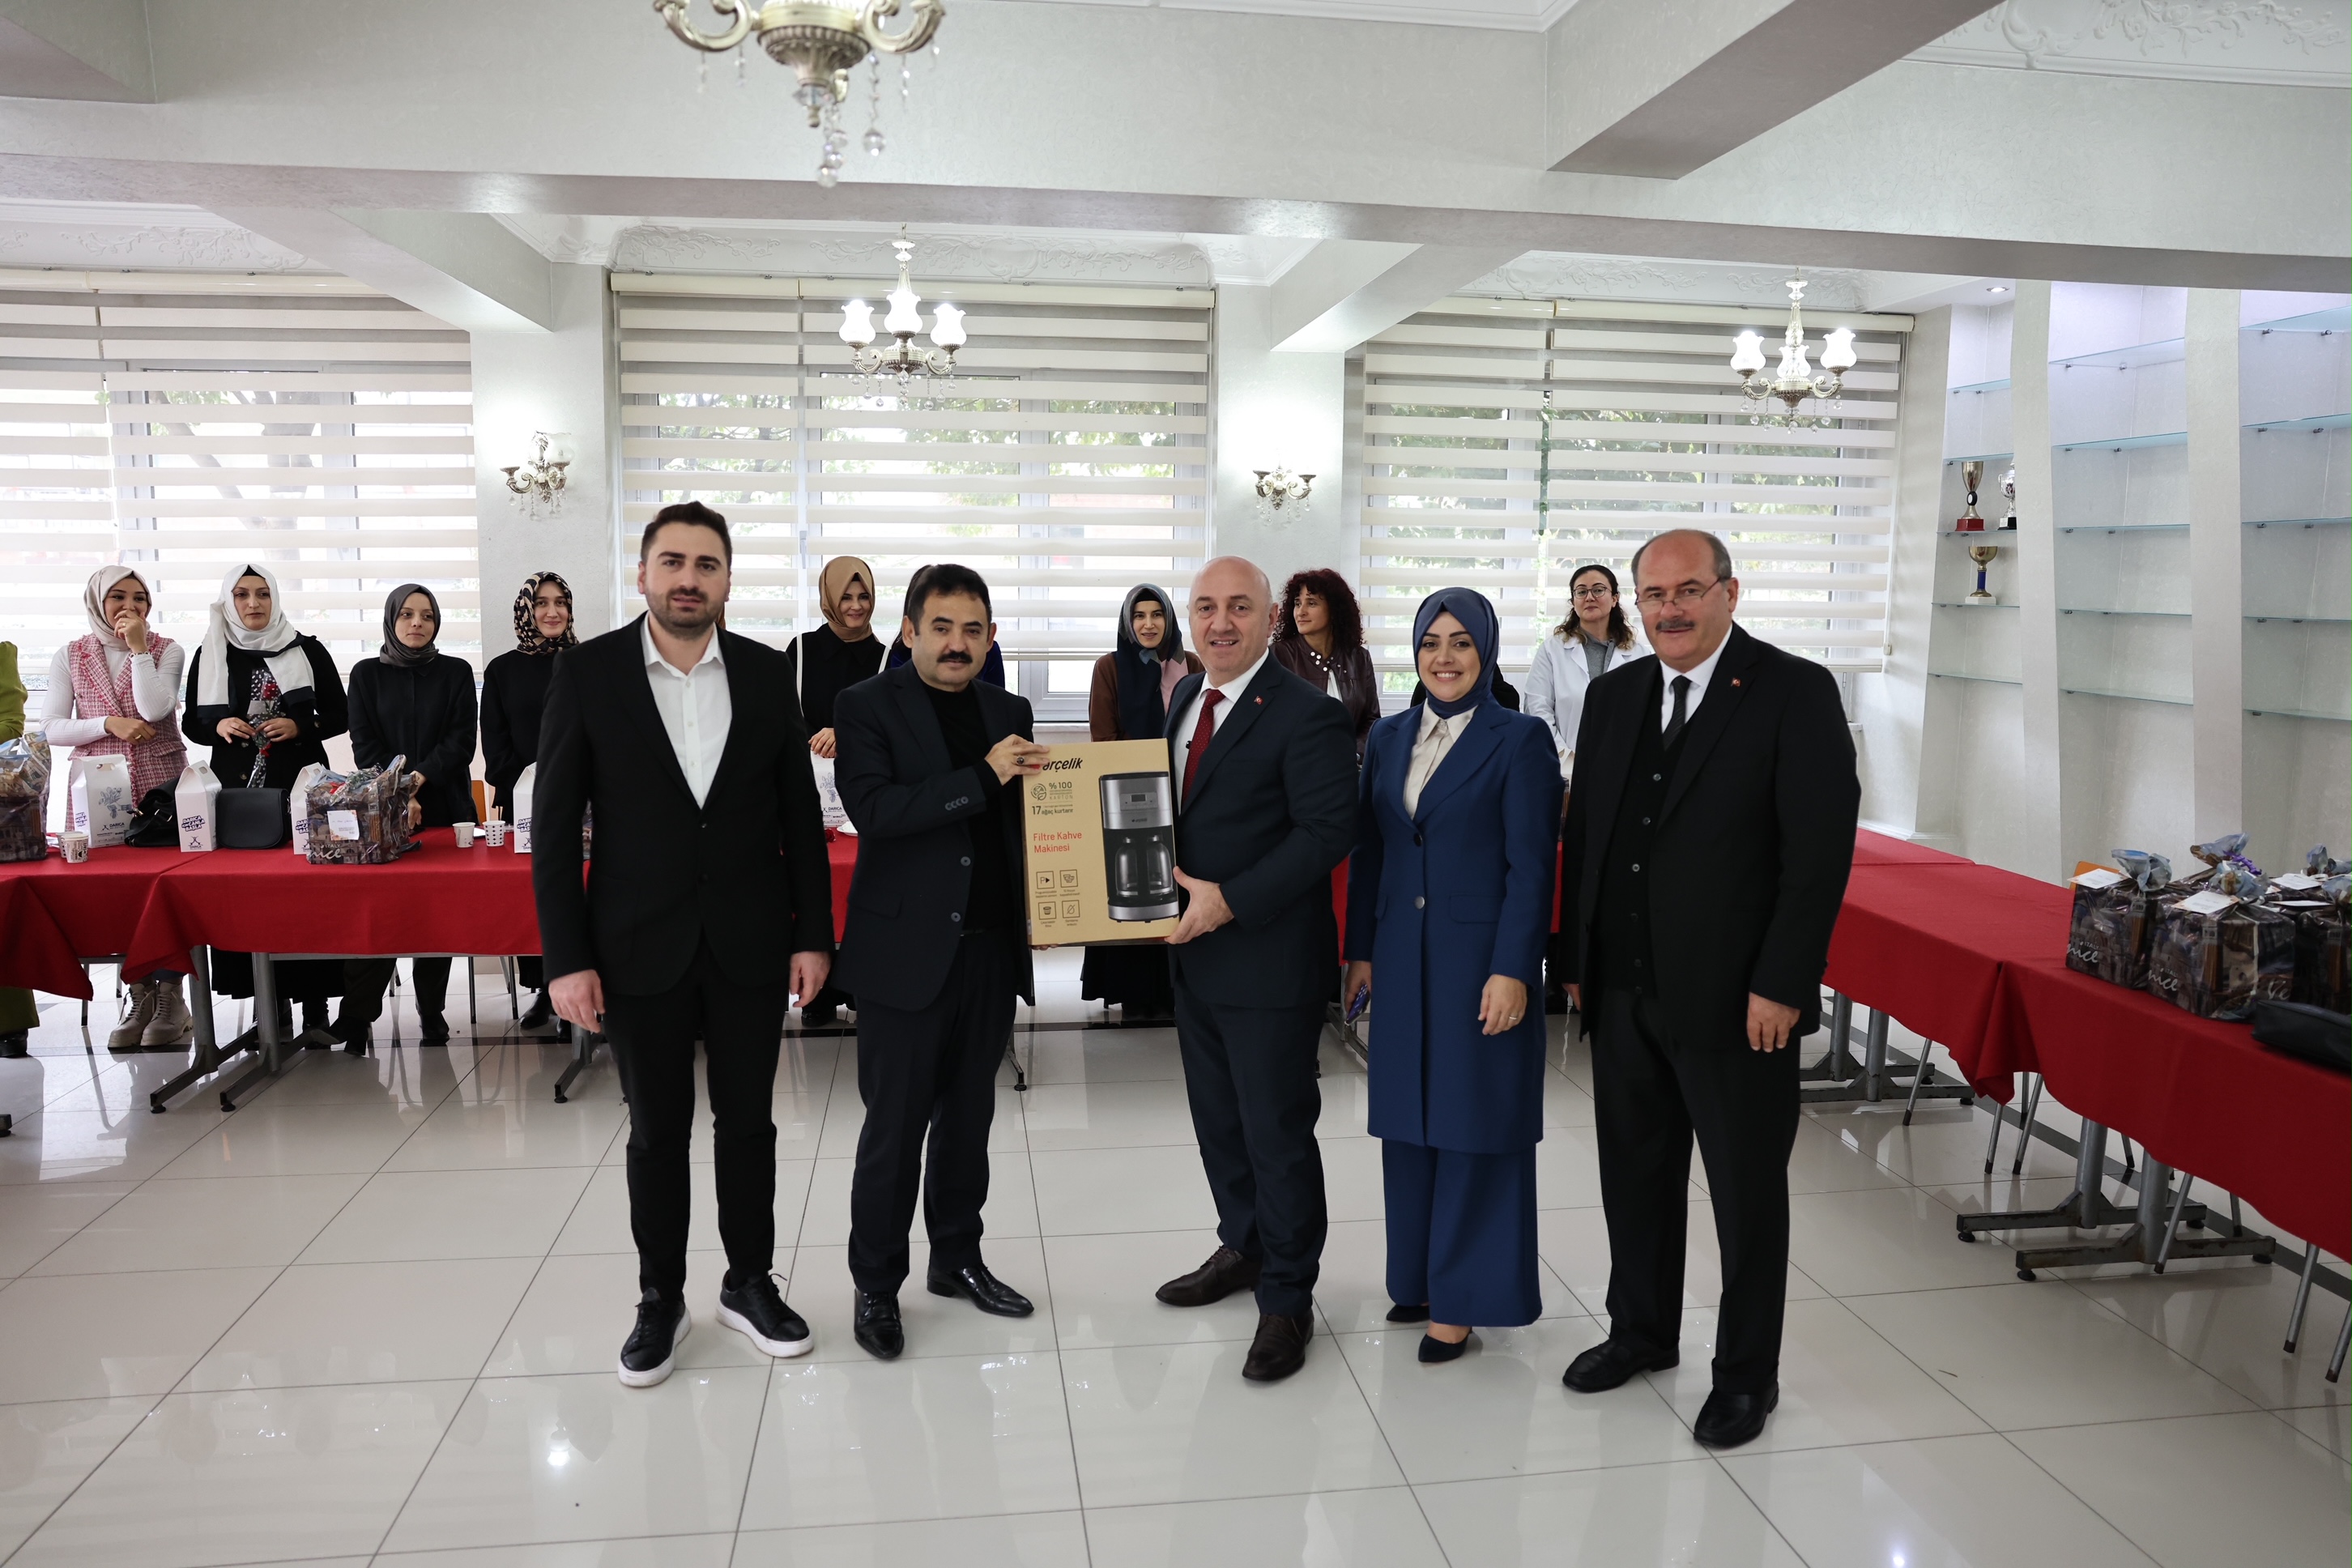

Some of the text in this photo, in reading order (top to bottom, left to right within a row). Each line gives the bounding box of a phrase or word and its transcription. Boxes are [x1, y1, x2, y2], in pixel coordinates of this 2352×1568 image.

[1042, 757, 1083, 773] arçelik
[1032, 806, 1042, 815] 17
[1033, 831, 1082, 841] Filtre Kahve
[1034, 844, 1070, 853] Makinesi
[2084, 942, 2099, 950] ITALY
